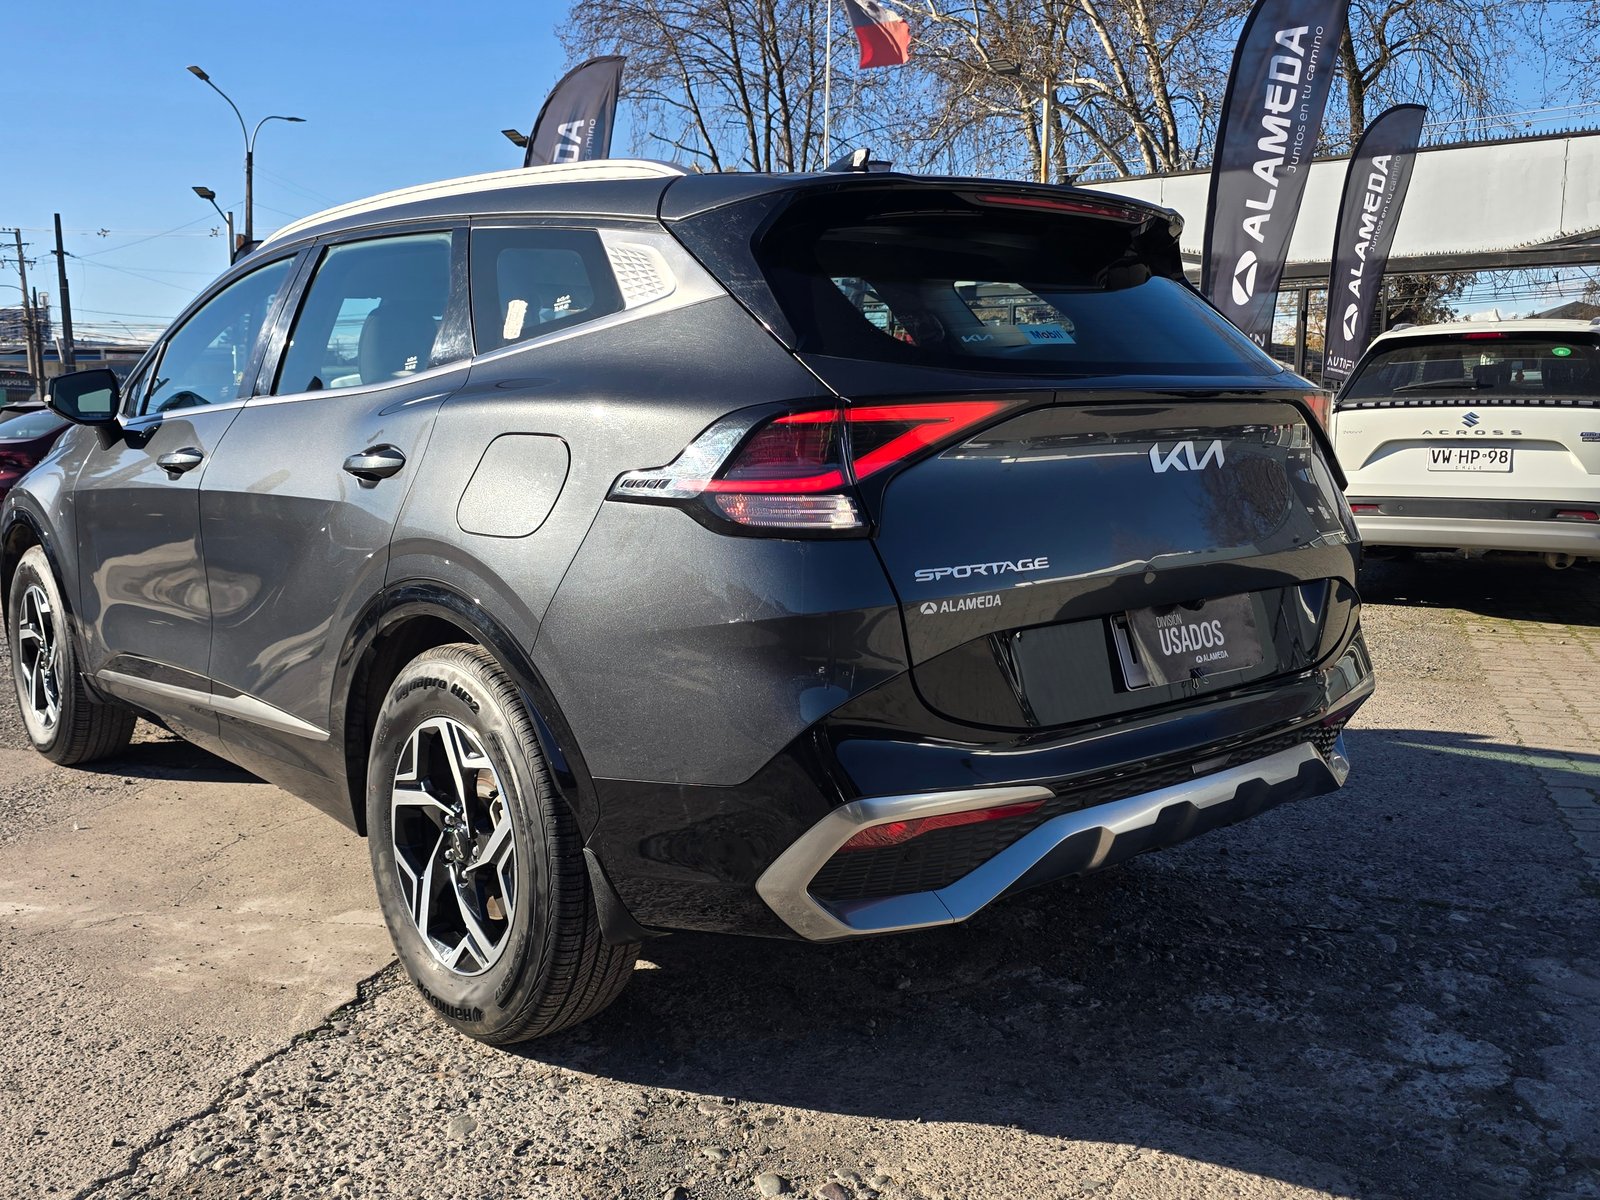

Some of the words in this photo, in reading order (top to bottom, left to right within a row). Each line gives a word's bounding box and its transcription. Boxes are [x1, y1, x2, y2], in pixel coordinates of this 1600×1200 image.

[1306, 26, 1324, 81] camino
[1302, 85, 1312, 100] tu
[1300, 103, 1309, 121] en
[585, 118, 596, 161] camino
[1242, 25, 1309, 243] ALAMEDA
[1286, 125, 1306, 173] Juntos
[1369, 220, 1384, 253] Juntos
[1381, 206, 1389, 218] en
[1385, 193, 1393, 203] tu
[1389, 155, 1401, 191] camino
[1348, 155, 1392, 299] ALAMEDA
[1031, 330, 1062, 340] Mobil
[1148, 439, 1225, 474] KIA
[914, 556, 1050, 582] SPORTAGE
[940, 594, 1002, 613] ALAMEDA
[1155, 611, 1183, 629] DIVISIÓN
[1158, 619, 1225, 656] USADOS
[1203, 650, 1229, 662] ALAMEDA
[450, 683, 480, 715] HP2
